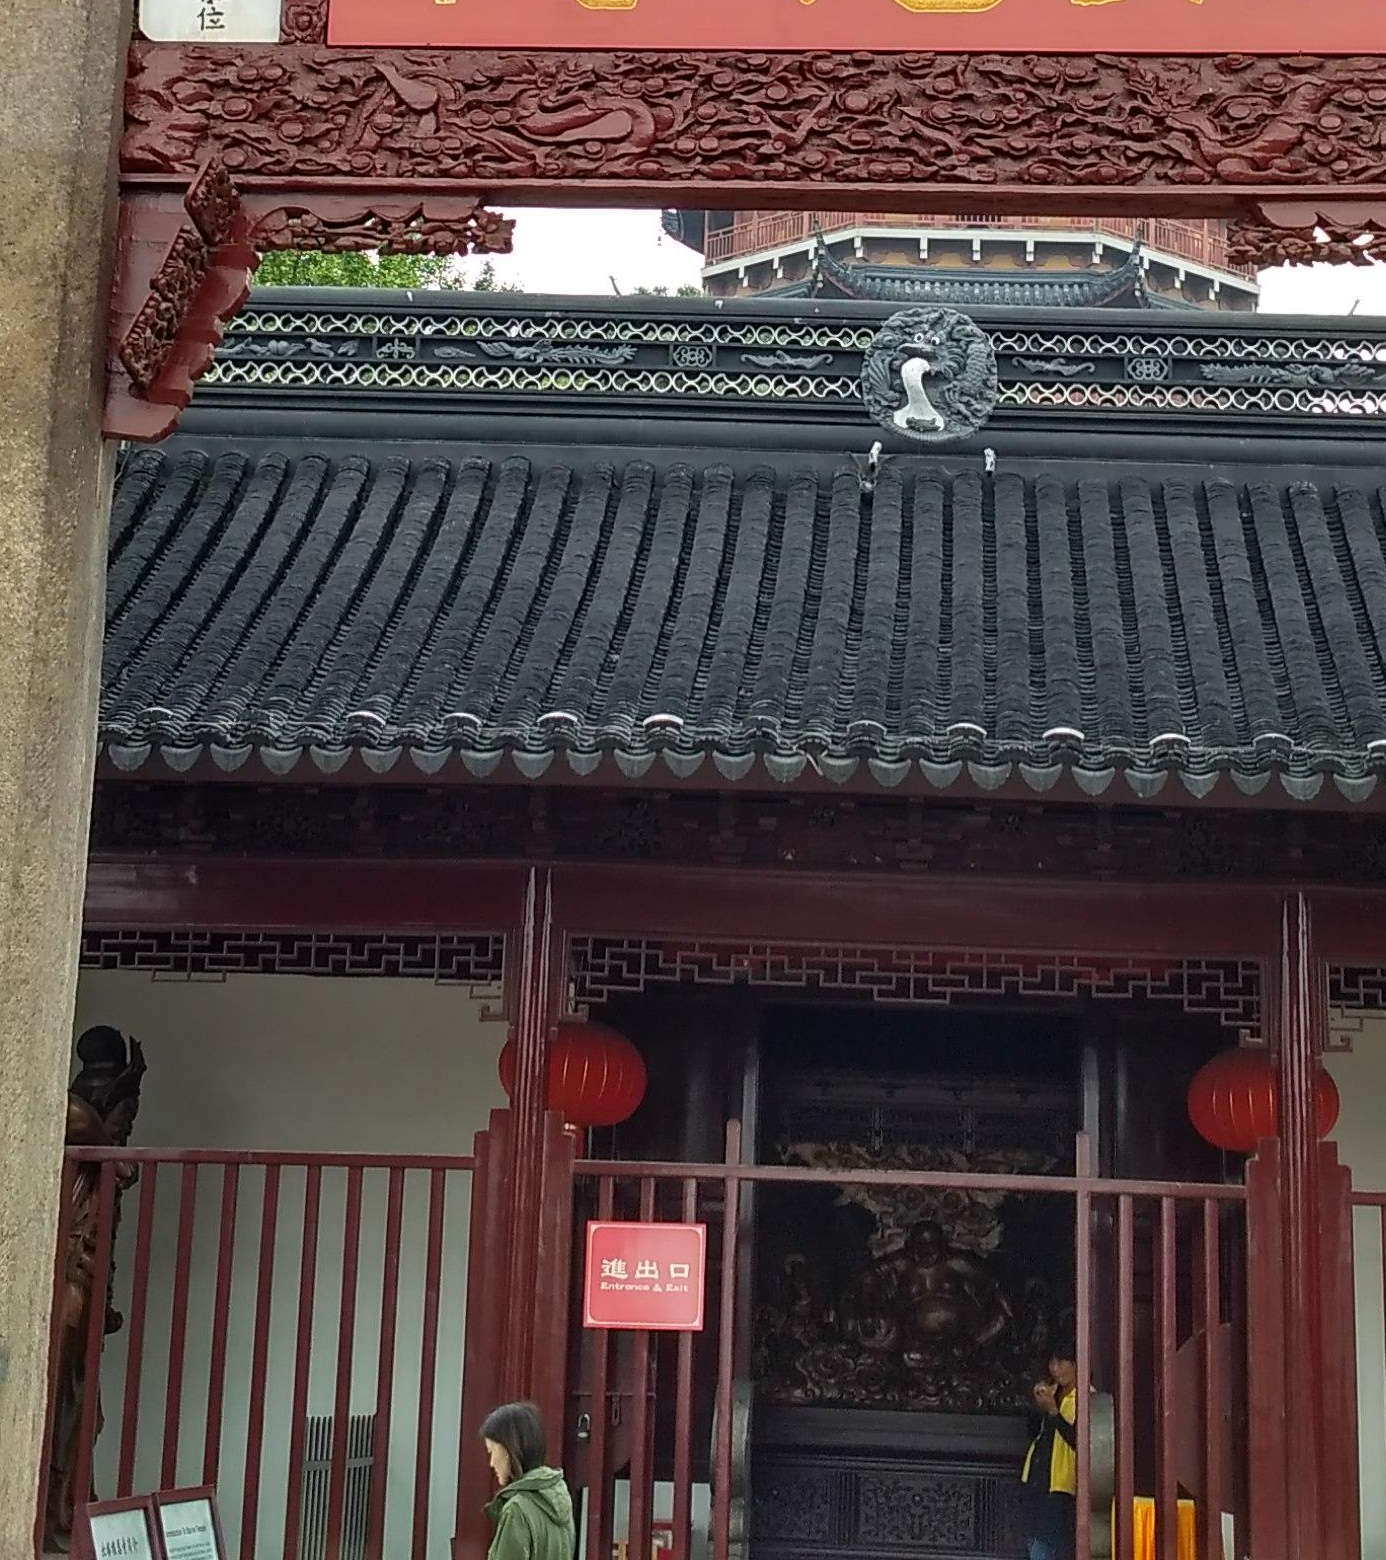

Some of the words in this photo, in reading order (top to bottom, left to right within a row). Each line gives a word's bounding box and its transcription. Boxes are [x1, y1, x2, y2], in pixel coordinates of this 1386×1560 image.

[600, 1258, 691, 1280] 進出口
[600, 1281, 650, 1292] Entrance
[652, 1283, 663, 1293] &
[665, 1283, 690, 1293] Exit
